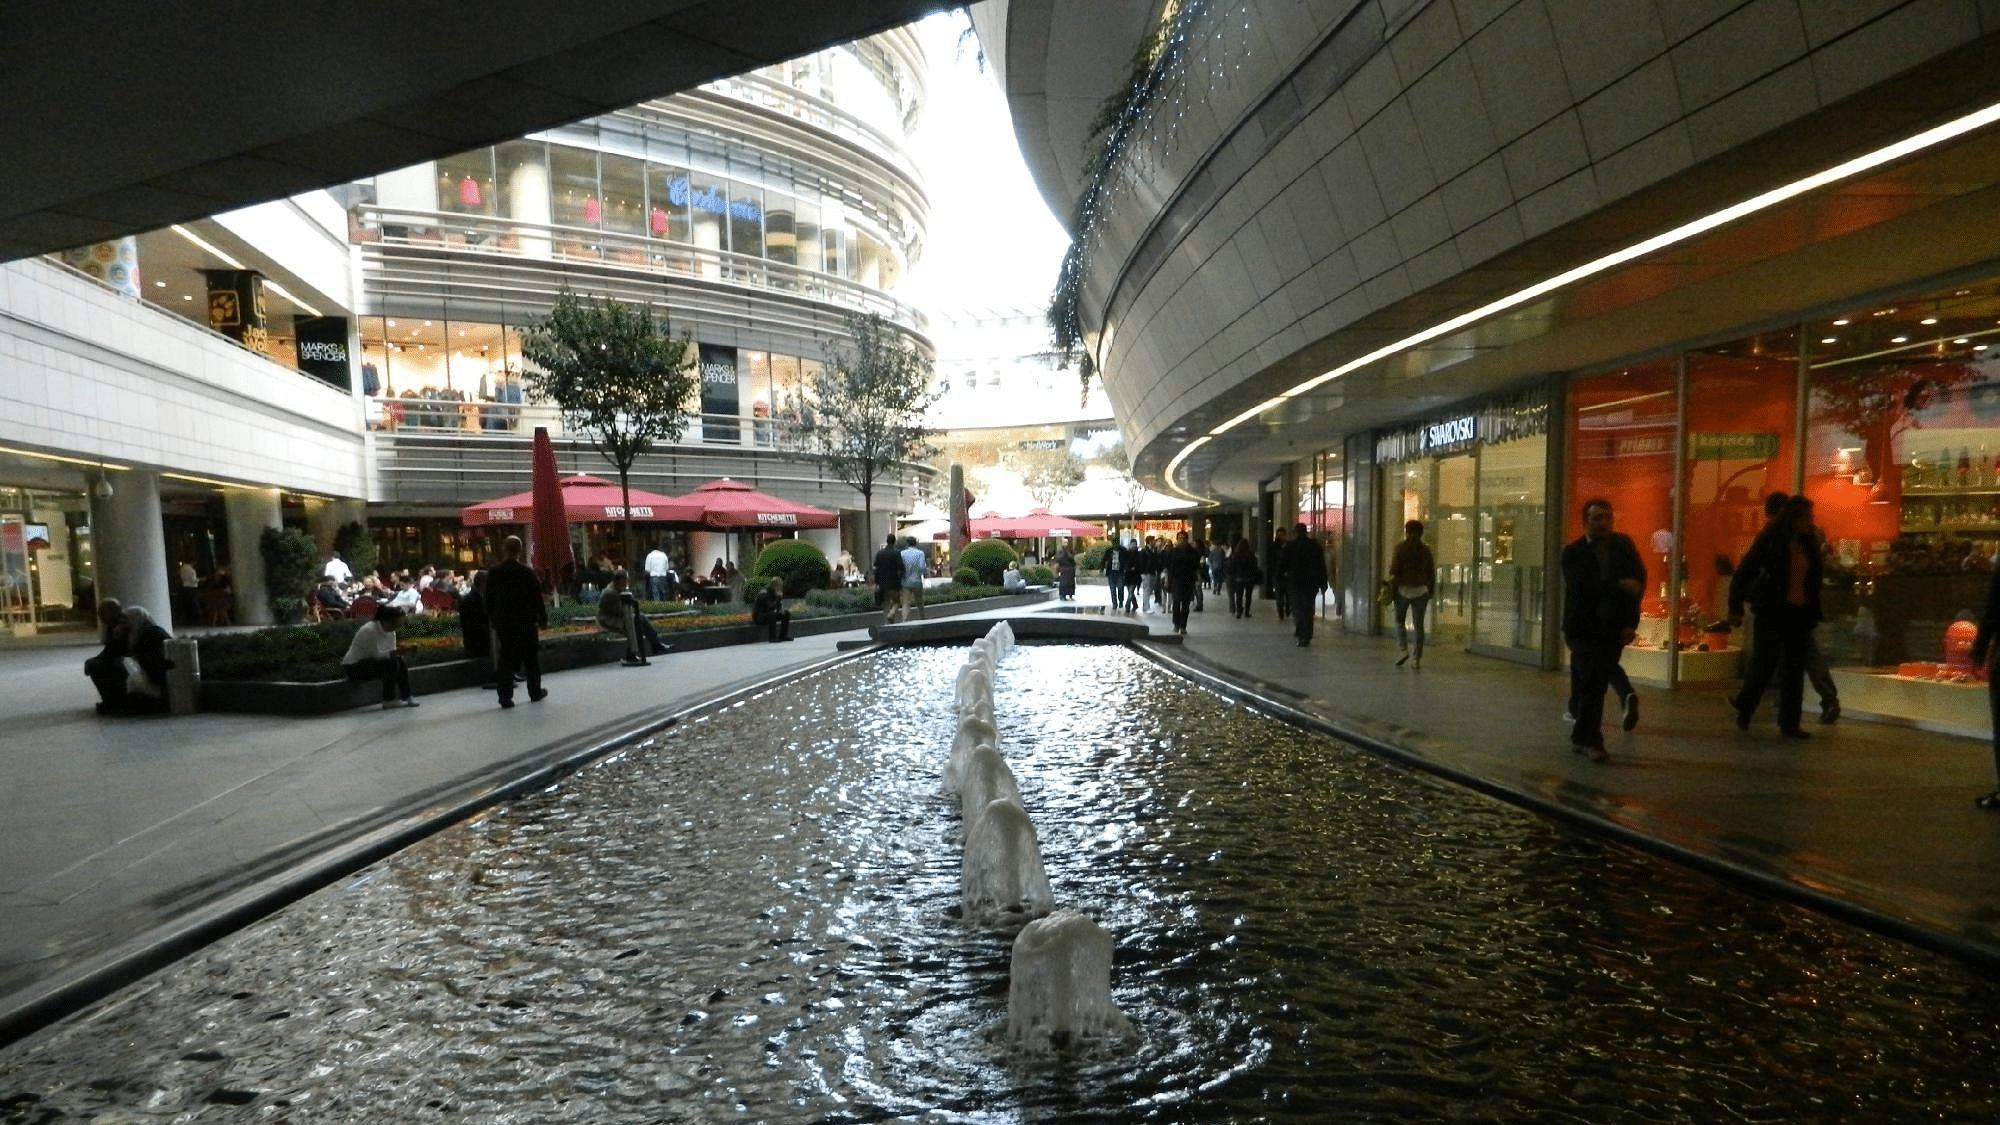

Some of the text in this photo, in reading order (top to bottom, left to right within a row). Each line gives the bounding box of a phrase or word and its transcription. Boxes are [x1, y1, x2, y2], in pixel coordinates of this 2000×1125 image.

[301, 342, 337, 353] MARKS
[302, 351, 346, 361] SPENCER
[702, 362, 729, 374] MARKS
[1429, 416, 1474, 447] SWAROVSKI
